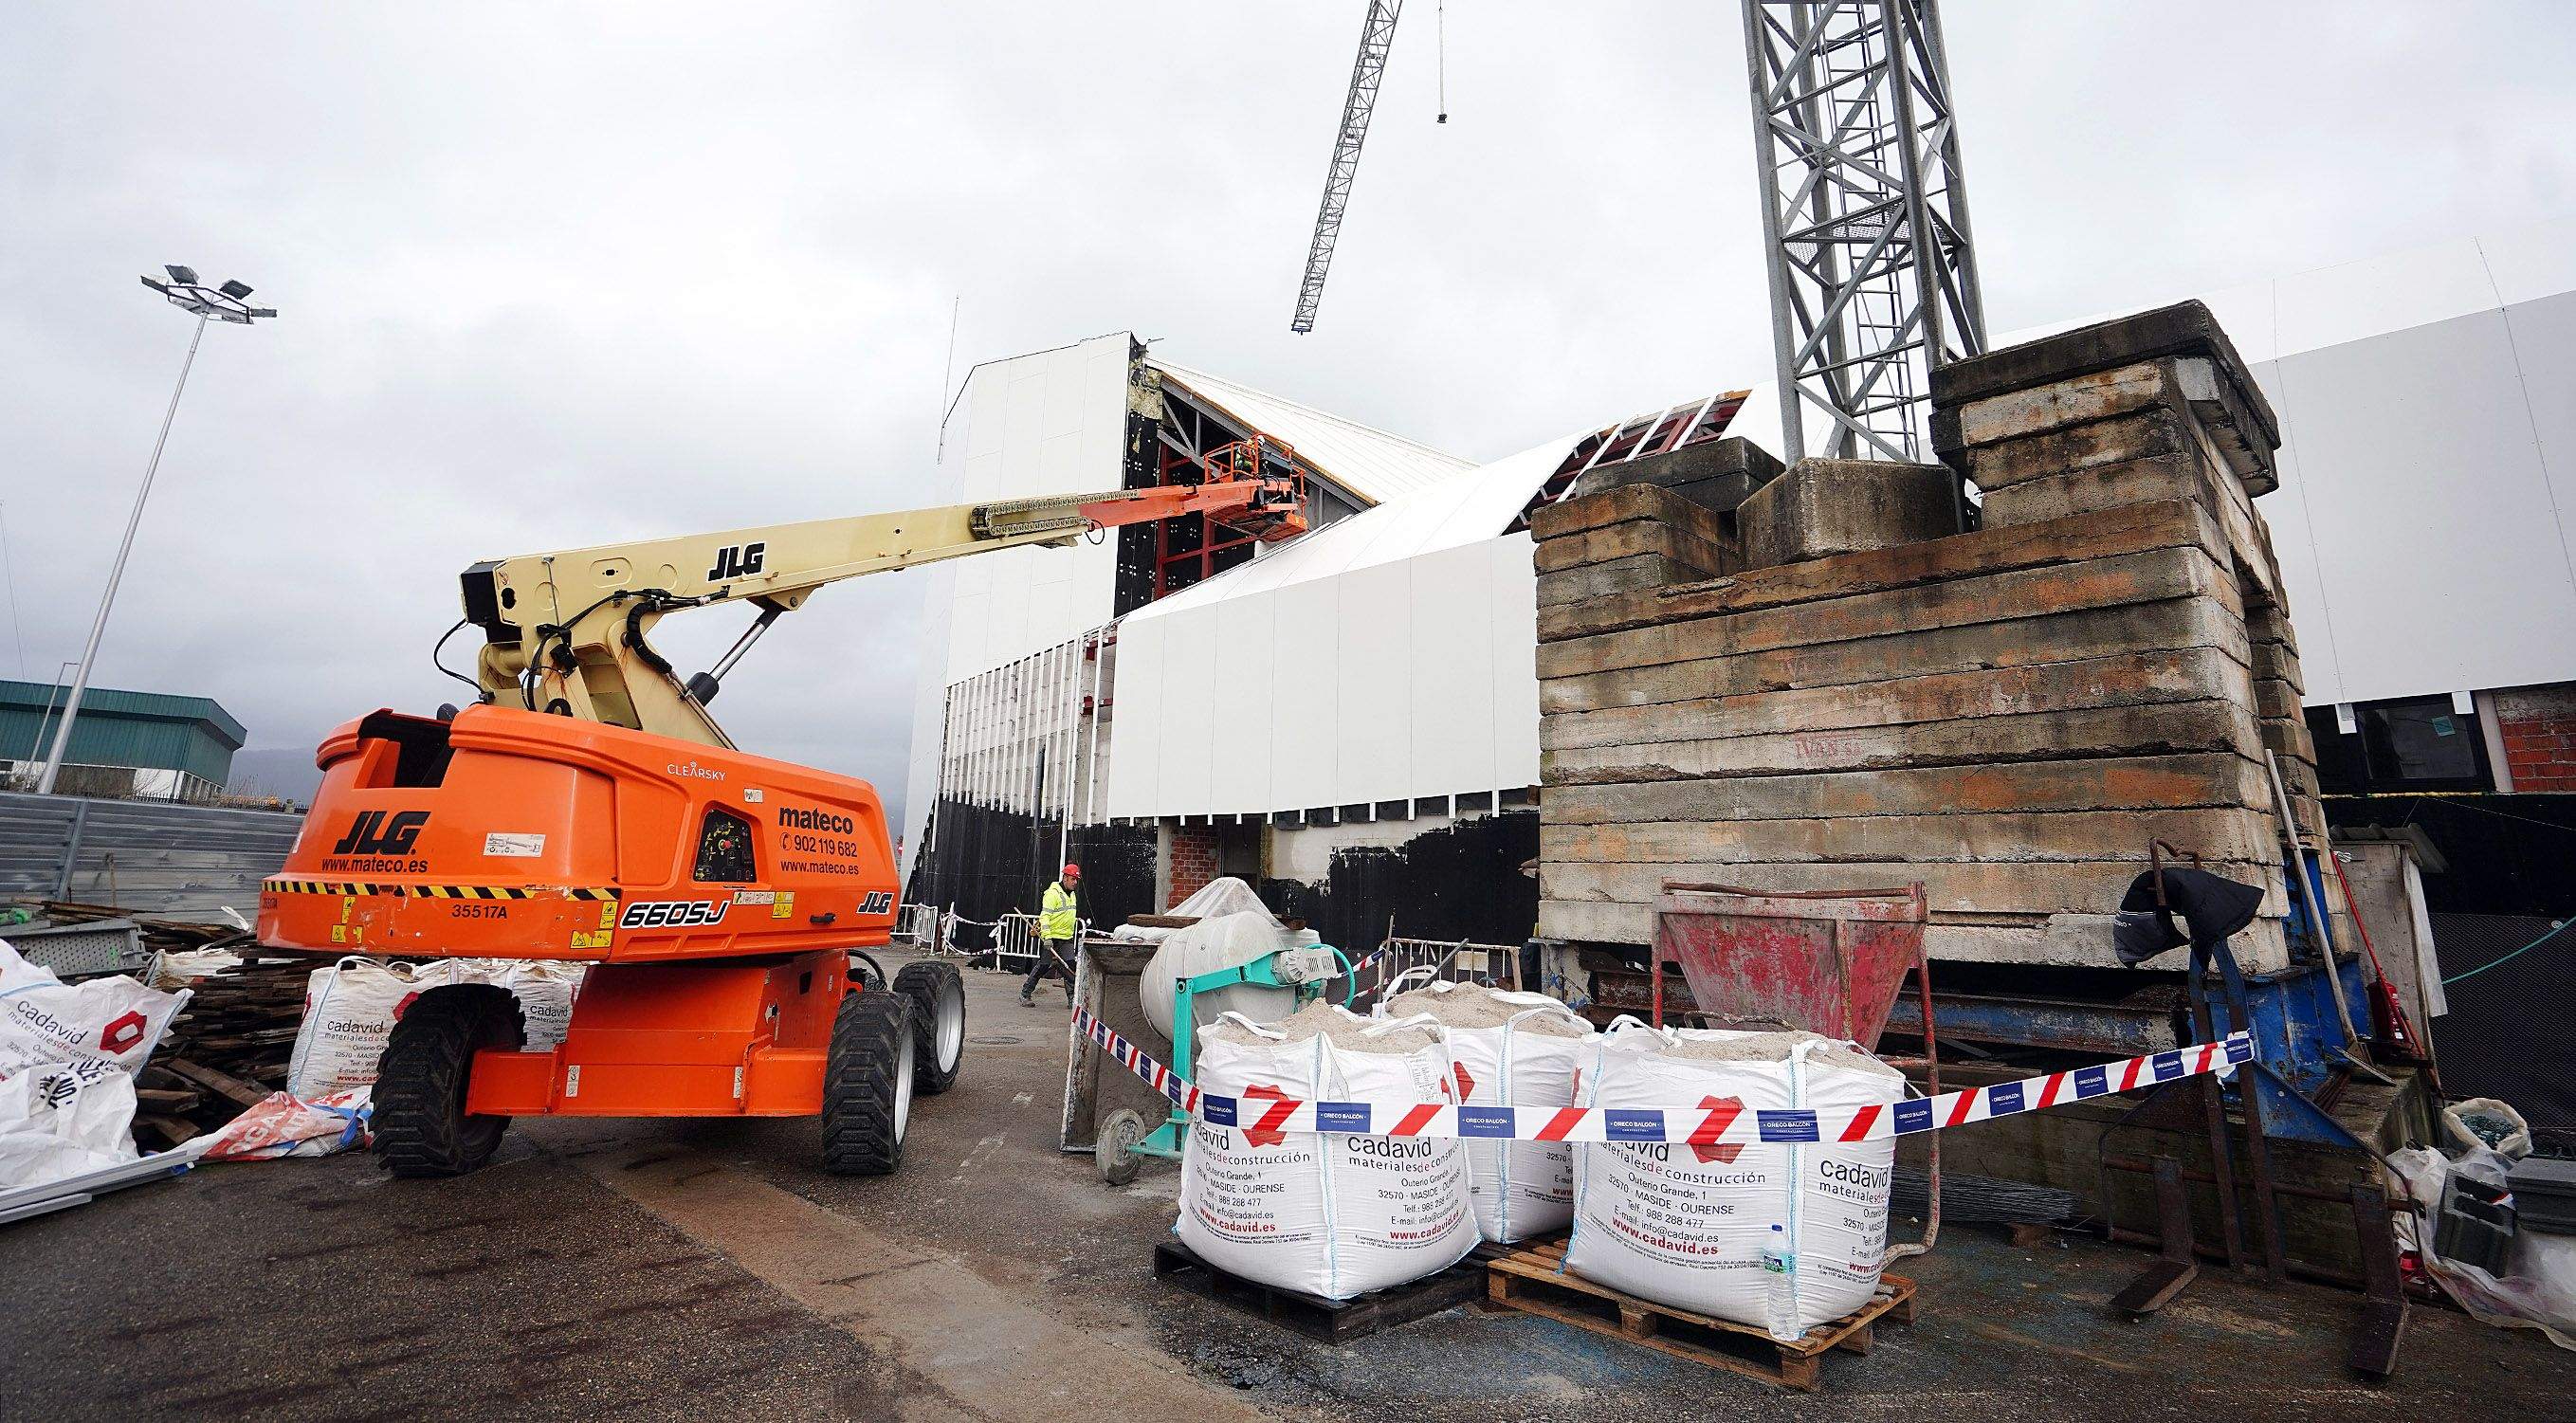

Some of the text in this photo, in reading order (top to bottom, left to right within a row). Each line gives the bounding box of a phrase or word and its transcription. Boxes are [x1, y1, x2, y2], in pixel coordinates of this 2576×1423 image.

[709, 542, 765, 581] JLG
[667, 763, 726, 781] CLEARSKY
[778, 807, 854, 835] mateco
[334, 812, 430, 855] JLG
[794, 835, 859, 859] 902 119 682
[321, 859, 428, 876] www.mateco.es
[780, 861, 860, 876] www.mateco.es
[450, 903, 508, 919] 35517A
[620, 901, 730, 929] 660SJ
[856, 891, 895, 916] JLG
[17, 1000, 88, 1045] cadavid
[327, 1020, 384, 1034] cadavid
[1347, 1136, 1432, 1159] cadavid
[1820, 1159, 1889, 1189] cadavid
[1210, 1178, 1237, 1194] MASIDE
[1242, 1183, 1286, 1195] OURENSE
[1378, 1189, 1405, 1200] 32570
[1410, 1186, 1439, 1201] MASIDE
[1609, 1174, 1735, 1215] 32570 MASIDE OURENSE
[1660, 1183, 1699, 1201] Grande,
[1702, 1191, 1707, 1200] 1
[1247, 1198, 1262, 1207] 477
[1626, 1198, 1705, 1229] Telf.: 988 288 477
[1612, 1215, 1719, 1255] www.cadavid.es
[1614, 1204, 1639, 1227] E-mail:
[1641, 1219, 1719, 1243] info@cadavid.es
[1842, 1216, 1864, 1231] 32570
